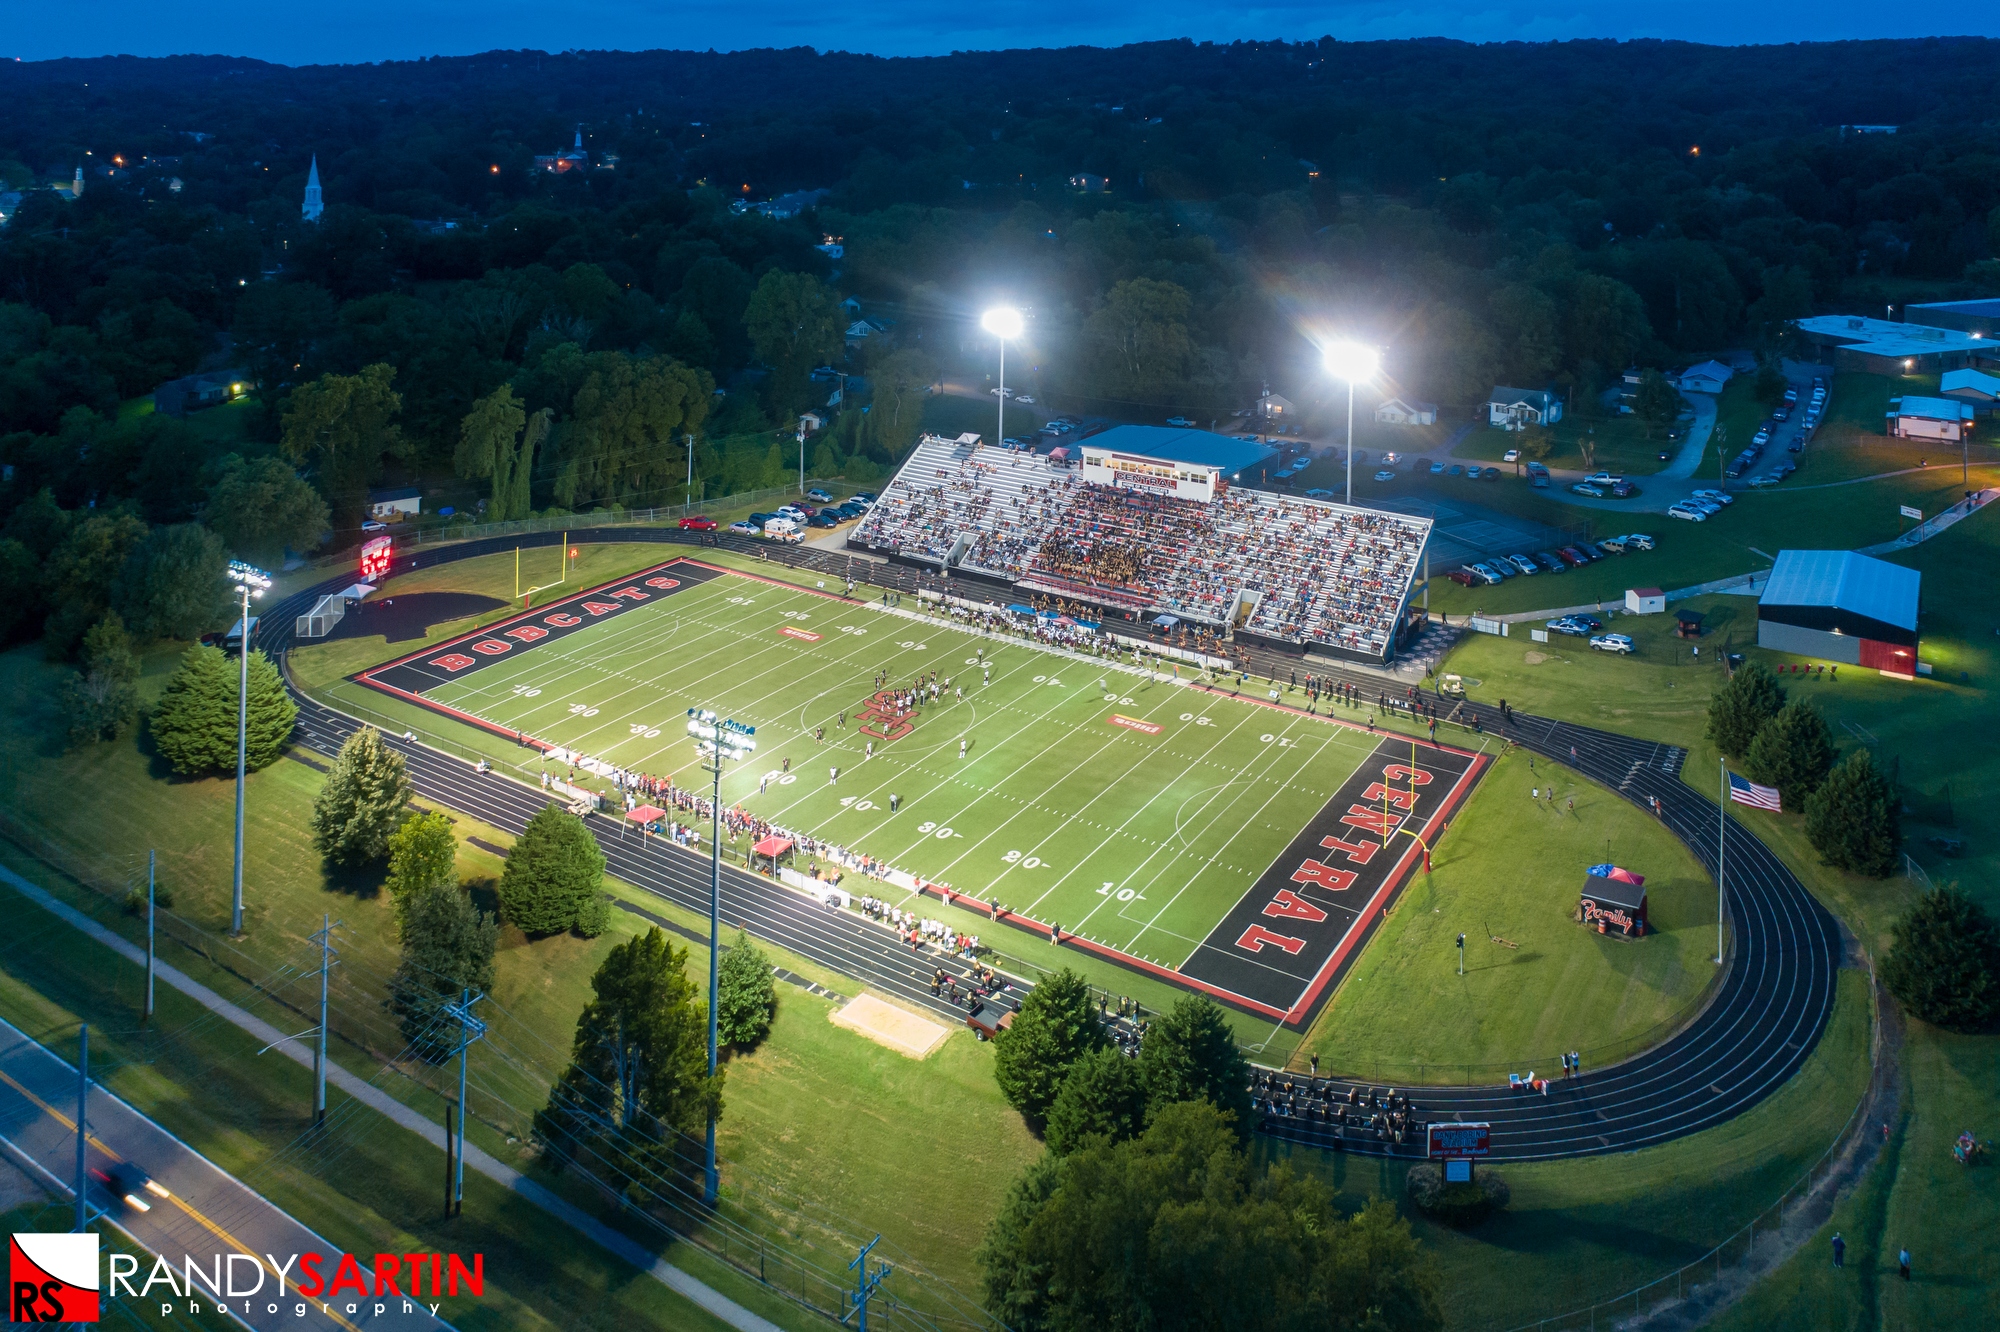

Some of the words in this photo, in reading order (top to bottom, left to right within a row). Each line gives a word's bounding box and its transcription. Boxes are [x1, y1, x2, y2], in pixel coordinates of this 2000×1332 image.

[1116, 472, 1175, 489] CENTRAL
[731, 597, 756, 606] 10
[784, 611, 811, 621] 20
[428, 577, 681, 672] BOBCATS
[841, 626, 868, 635] 30
[900, 641, 927, 651] 40
[1032, 675, 1060, 686] 40
[513, 685, 542, 697] 10
[1103, 693, 1134, 706] 30
[568, 704, 599, 718] 20
[1179, 713, 1212, 726] 20
[630, 725, 661, 738] 30
[840, 796, 873, 811] 40
[917, 822, 953, 839] 30
[1001, 850, 1041, 869] 20
[1235, 764, 1433, 955] CENTRAL
[1095, 882, 1135, 901] 10
[1581, 899, 1633, 934] Family
[1442, 1139, 1478, 1148] STADIUM
